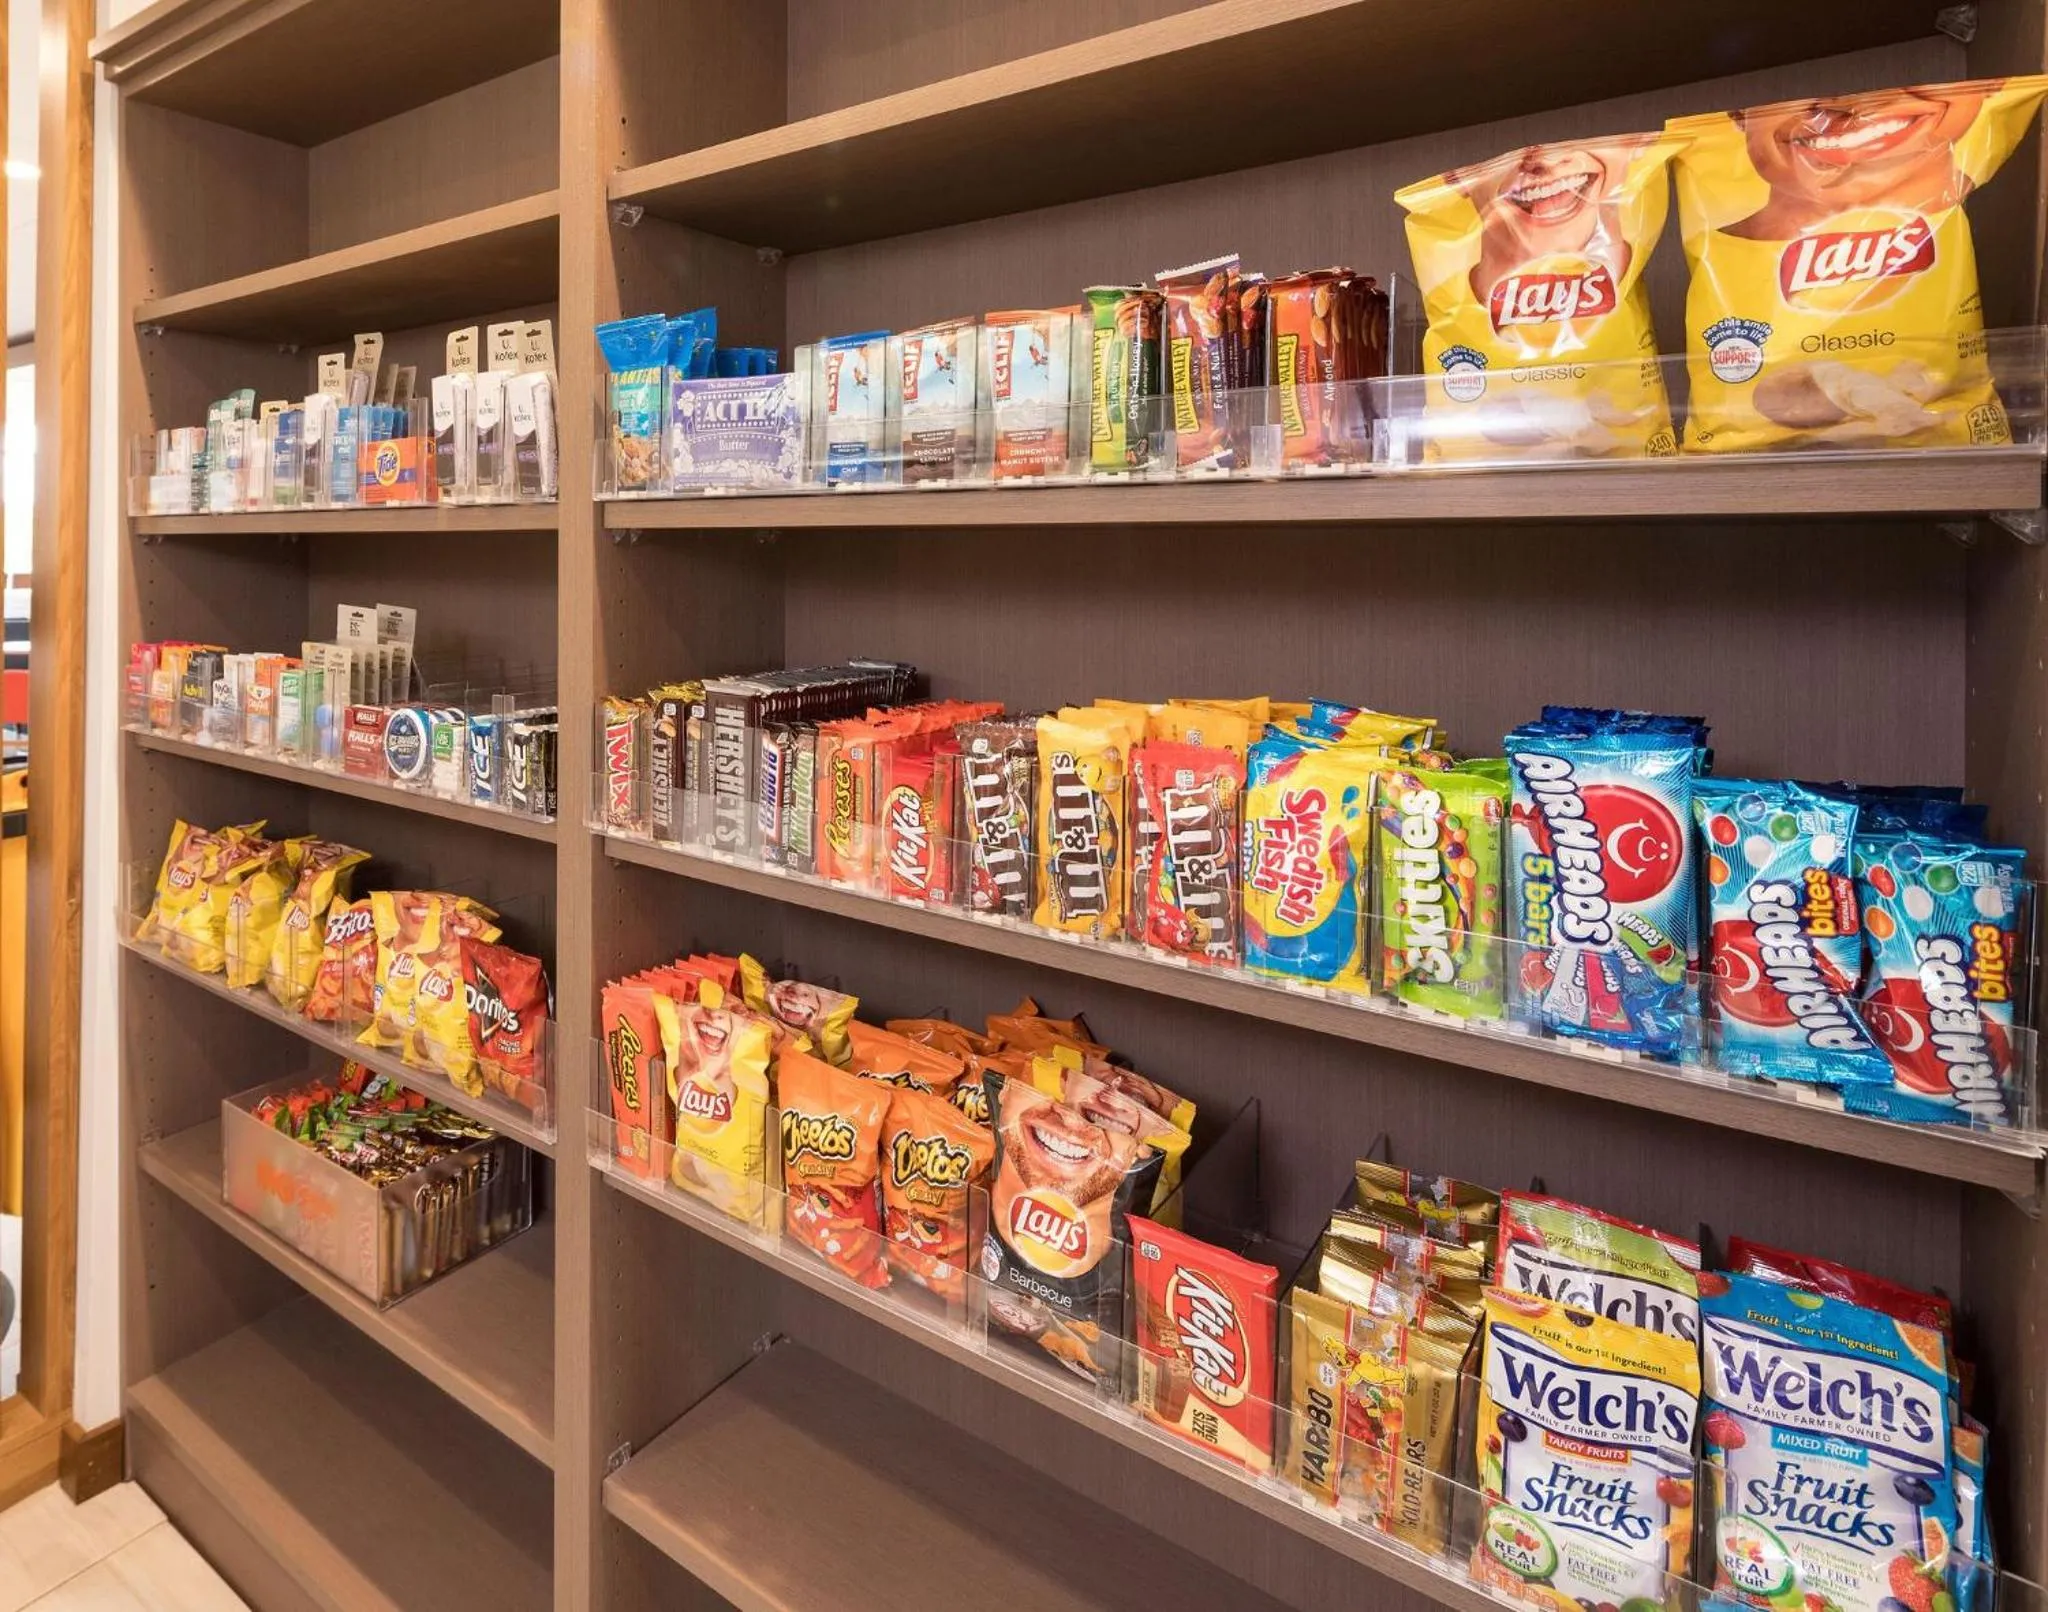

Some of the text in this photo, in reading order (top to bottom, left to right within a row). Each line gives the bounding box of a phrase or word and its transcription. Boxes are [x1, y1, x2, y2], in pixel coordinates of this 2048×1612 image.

[1790, 226, 1924, 293] Lay's
[1499, 273, 1607, 326] Lay's
[495, 352, 519, 361] kotex
[524, 353, 548, 365] kotex
[904, 343, 920, 389] CLIF
[995, 334, 1010, 383] CLIF
[1800, 329, 1896, 355] Classic
[1092, 333, 1108, 437] NATURE VALLEY
[1172, 342, 1196, 431] NATURE VALLEY
[1211, 351, 1223, 409] Fruit & Nut
[1279, 340, 1301, 432] NATURE VALLEY
[1321, 358, 1336, 402] Almond
[1510, 362, 1586, 384] Classic
[703, 400, 741, 421] ACT
[1128, 394, 1139, 420] Oats
[1970, 407, 2000, 428] 240
[377, 452, 398, 477] Tide
[719, 440, 749, 451] Butter
[914, 447, 955, 457] CHOCOLATE
[348, 730, 375, 745] HALLS
[356, 711, 377, 722] HALLS
[471, 730, 493, 791] ICE
[507, 739, 527, 803] ICE
[607, 720, 635, 814] TWIX
[714, 705, 746, 846] HERSHEY'S
[824, 755, 852, 858] Reese's
[1254, 815, 1295, 894] Fish
[1278, 788, 1326, 926] Swedish
[1514, 753, 1614, 945] AIRHEADS
[1961, 862, 1978, 884] 220
[170, 868, 196, 889] Lay's
[1394, 789, 1455, 984] Skittles
[1524, 854, 1554, 947] 5 bars
[1801, 867, 1837, 938] bites
[286, 907, 310, 929] Lay's
[420, 968, 451, 998] Lay's
[1748, 881, 1872, 1051] AIRHEADS
[1969, 924, 2006, 1001] bites
[463, 983, 519, 1032] Doritos
[1916, 935, 2006, 1115] AIRHEADS
[680, 1081, 728, 1120] Lay's
[783, 1112, 854, 1163] Cheetos
[893, 1133, 970, 1188] Chetos
[1014, 1199, 1084, 1254] Lay's
[1009, 1267, 1072, 1309] Barbecue
[1532, 1325, 1562, 1342] Fruit
[1565, 1336, 1573, 1350] is
[1575, 1343, 1593, 1355] our
[1611, 1352, 1667, 1376] Ingredient!
[1747, 1309, 1779, 1326] Fruit
[1784, 1321, 1793, 1332] is
[1797, 1326, 1815, 1336] our
[1837, 1334, 1898, 1361] Ingredient!
[1497, 1348, 1691, 1445] Welch's
[1712, 1337, 1934, 1444] Welch's
[1192, 1409, 1205, 1438] SIZE
[1205, 1413, 1219, 1445] KING
[1301, 1387, 1334, 1489] HARIBO
[1524, 1408, 1653, 1444] FAMILY FARMER OWNED
[1547, 1434, 1626, 1460] TANGY FRUITS
[1746, 1404, 1892, 1443] FAMILY FARMER OWNED
[1777, 1432, 1864, 1461] MIXED FRUIT
[1545, 1461, 1639, 1505] Fruit
[1772, 1461, 1876, 1510] Fruit
[1521, 1477, 1653, 1541] Snacks
[1744, 1479, 1897, 1547] Snacks
[1494, 1539, 1540, 1568] REAL
[1568, 1557, 1617, 1582] FAT FREE
[1724, 1555, 1776, 1582] REAL
[1801, 1559, 1860, 1588] FAT FREE
